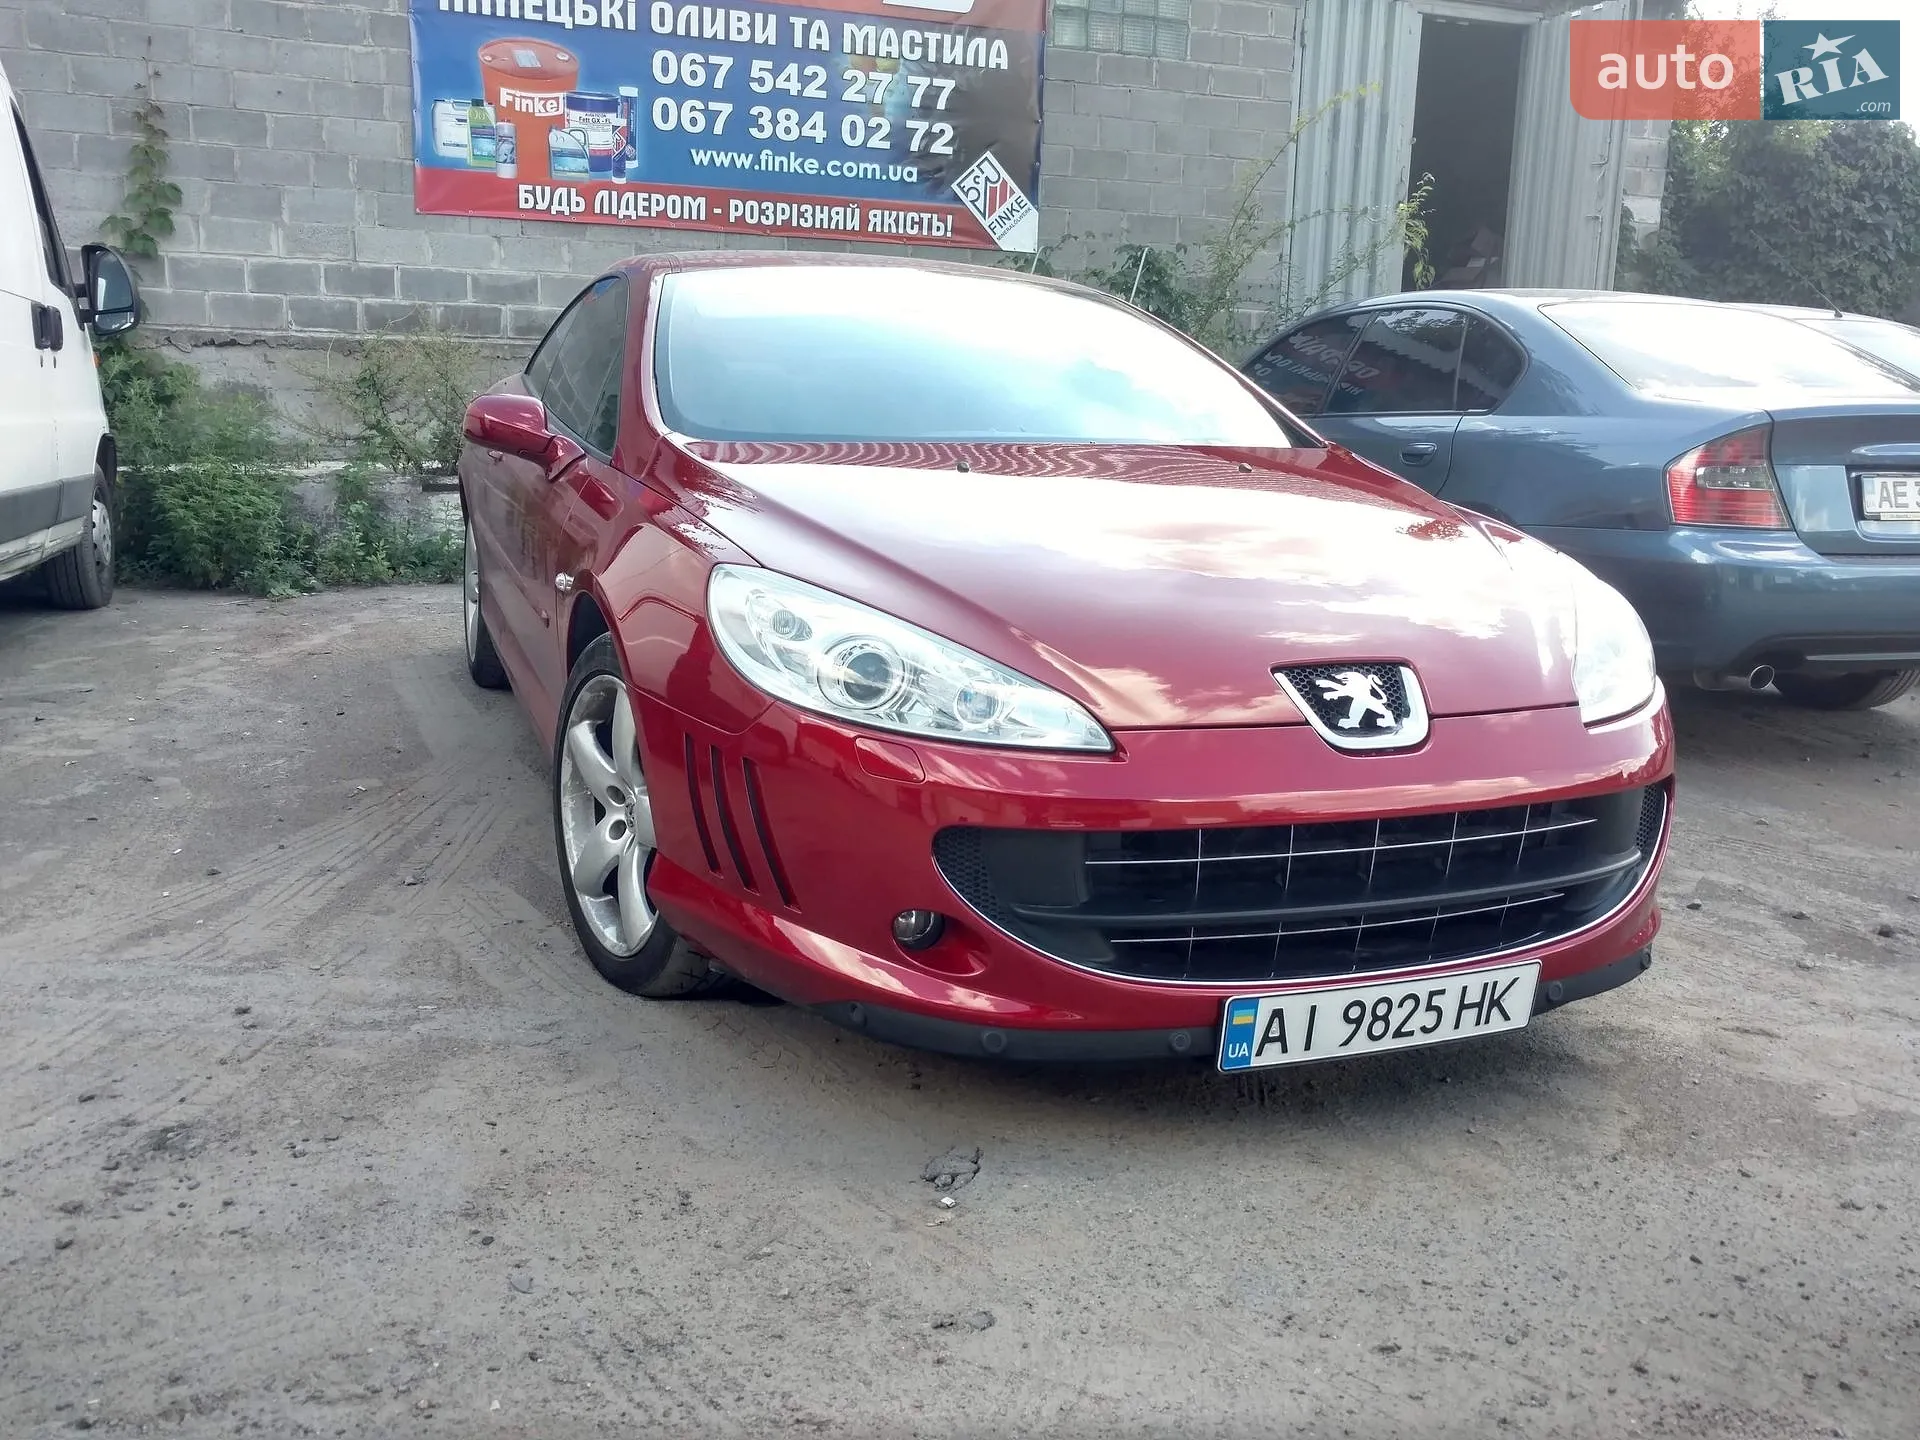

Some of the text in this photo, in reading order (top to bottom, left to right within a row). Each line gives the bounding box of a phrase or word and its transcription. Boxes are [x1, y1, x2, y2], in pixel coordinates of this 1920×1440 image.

[651, 1, 777, 45] ОЛИВИ
[789, 16, 830, 51] ТА
[843, 22, 1009, 70] МАСТИЛА
[500, 87, 559, 114] Finke
[652, 49, 956, 110] 067 542 27 77
[652, 97, 954, 155] 067 384 02 72
[691, 148, 918, 184] www.finke.com.ua
[518, 184, 586, 215] БУДЬ
[594, 190, 706, 221] ЛІДЕРОМ
[729, 198, 860, 231] РОЗРІЗНЯЙ
[867, 208, 953, 237] ЯКІСТЬ!
[987, 195, 1028, 236] FINKE
[1228, 976, 1520, 1058] UA AI 9825 HK
